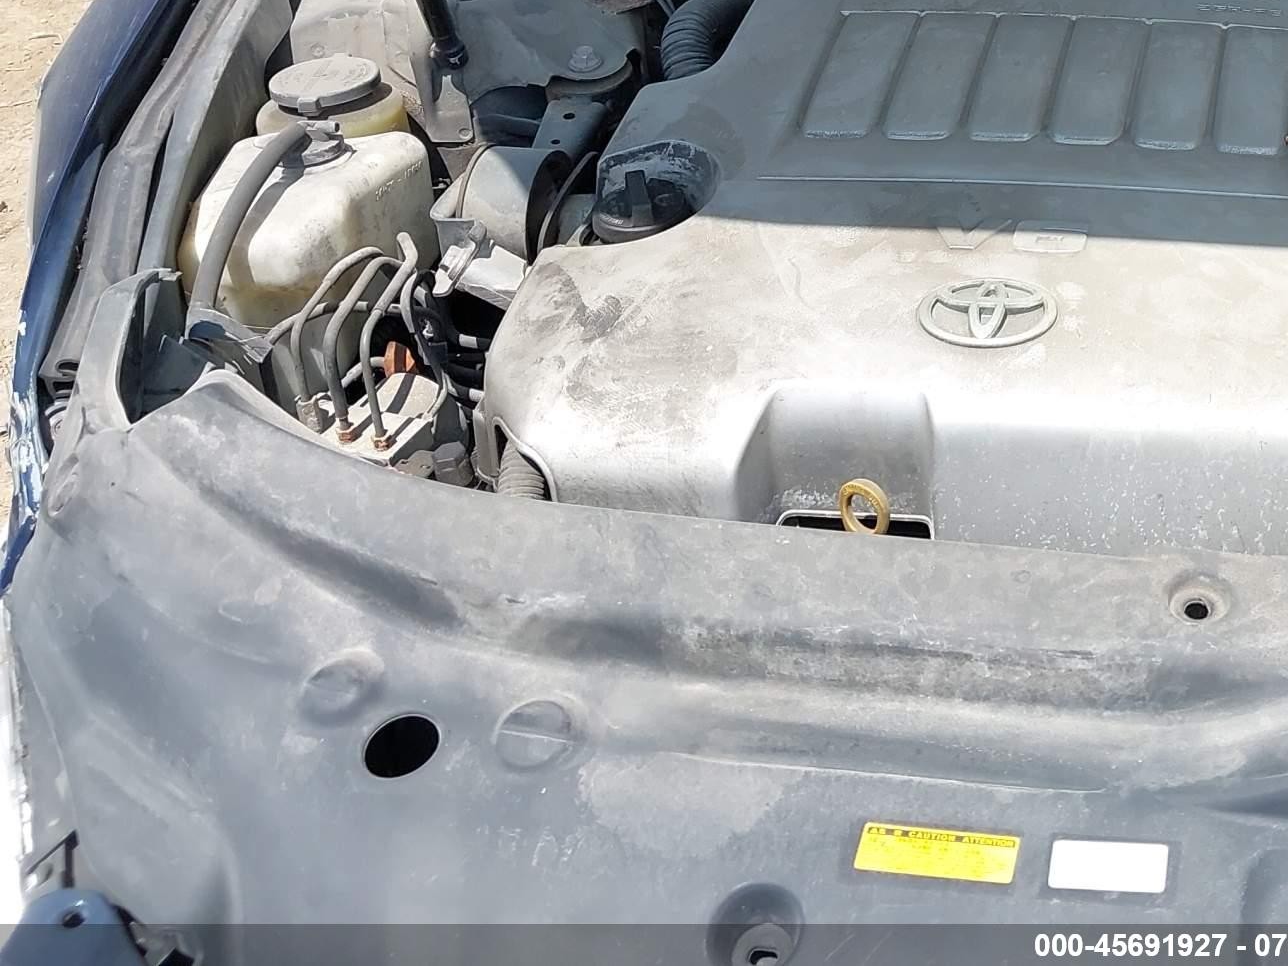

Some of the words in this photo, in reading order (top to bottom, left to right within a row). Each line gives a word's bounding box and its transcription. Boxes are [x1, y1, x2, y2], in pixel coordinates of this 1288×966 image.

[930, 218, 1089, 253] V6
[908, 831, 956, 842] CAUTION
[962, 836, 1014, 847] ATTENTION
